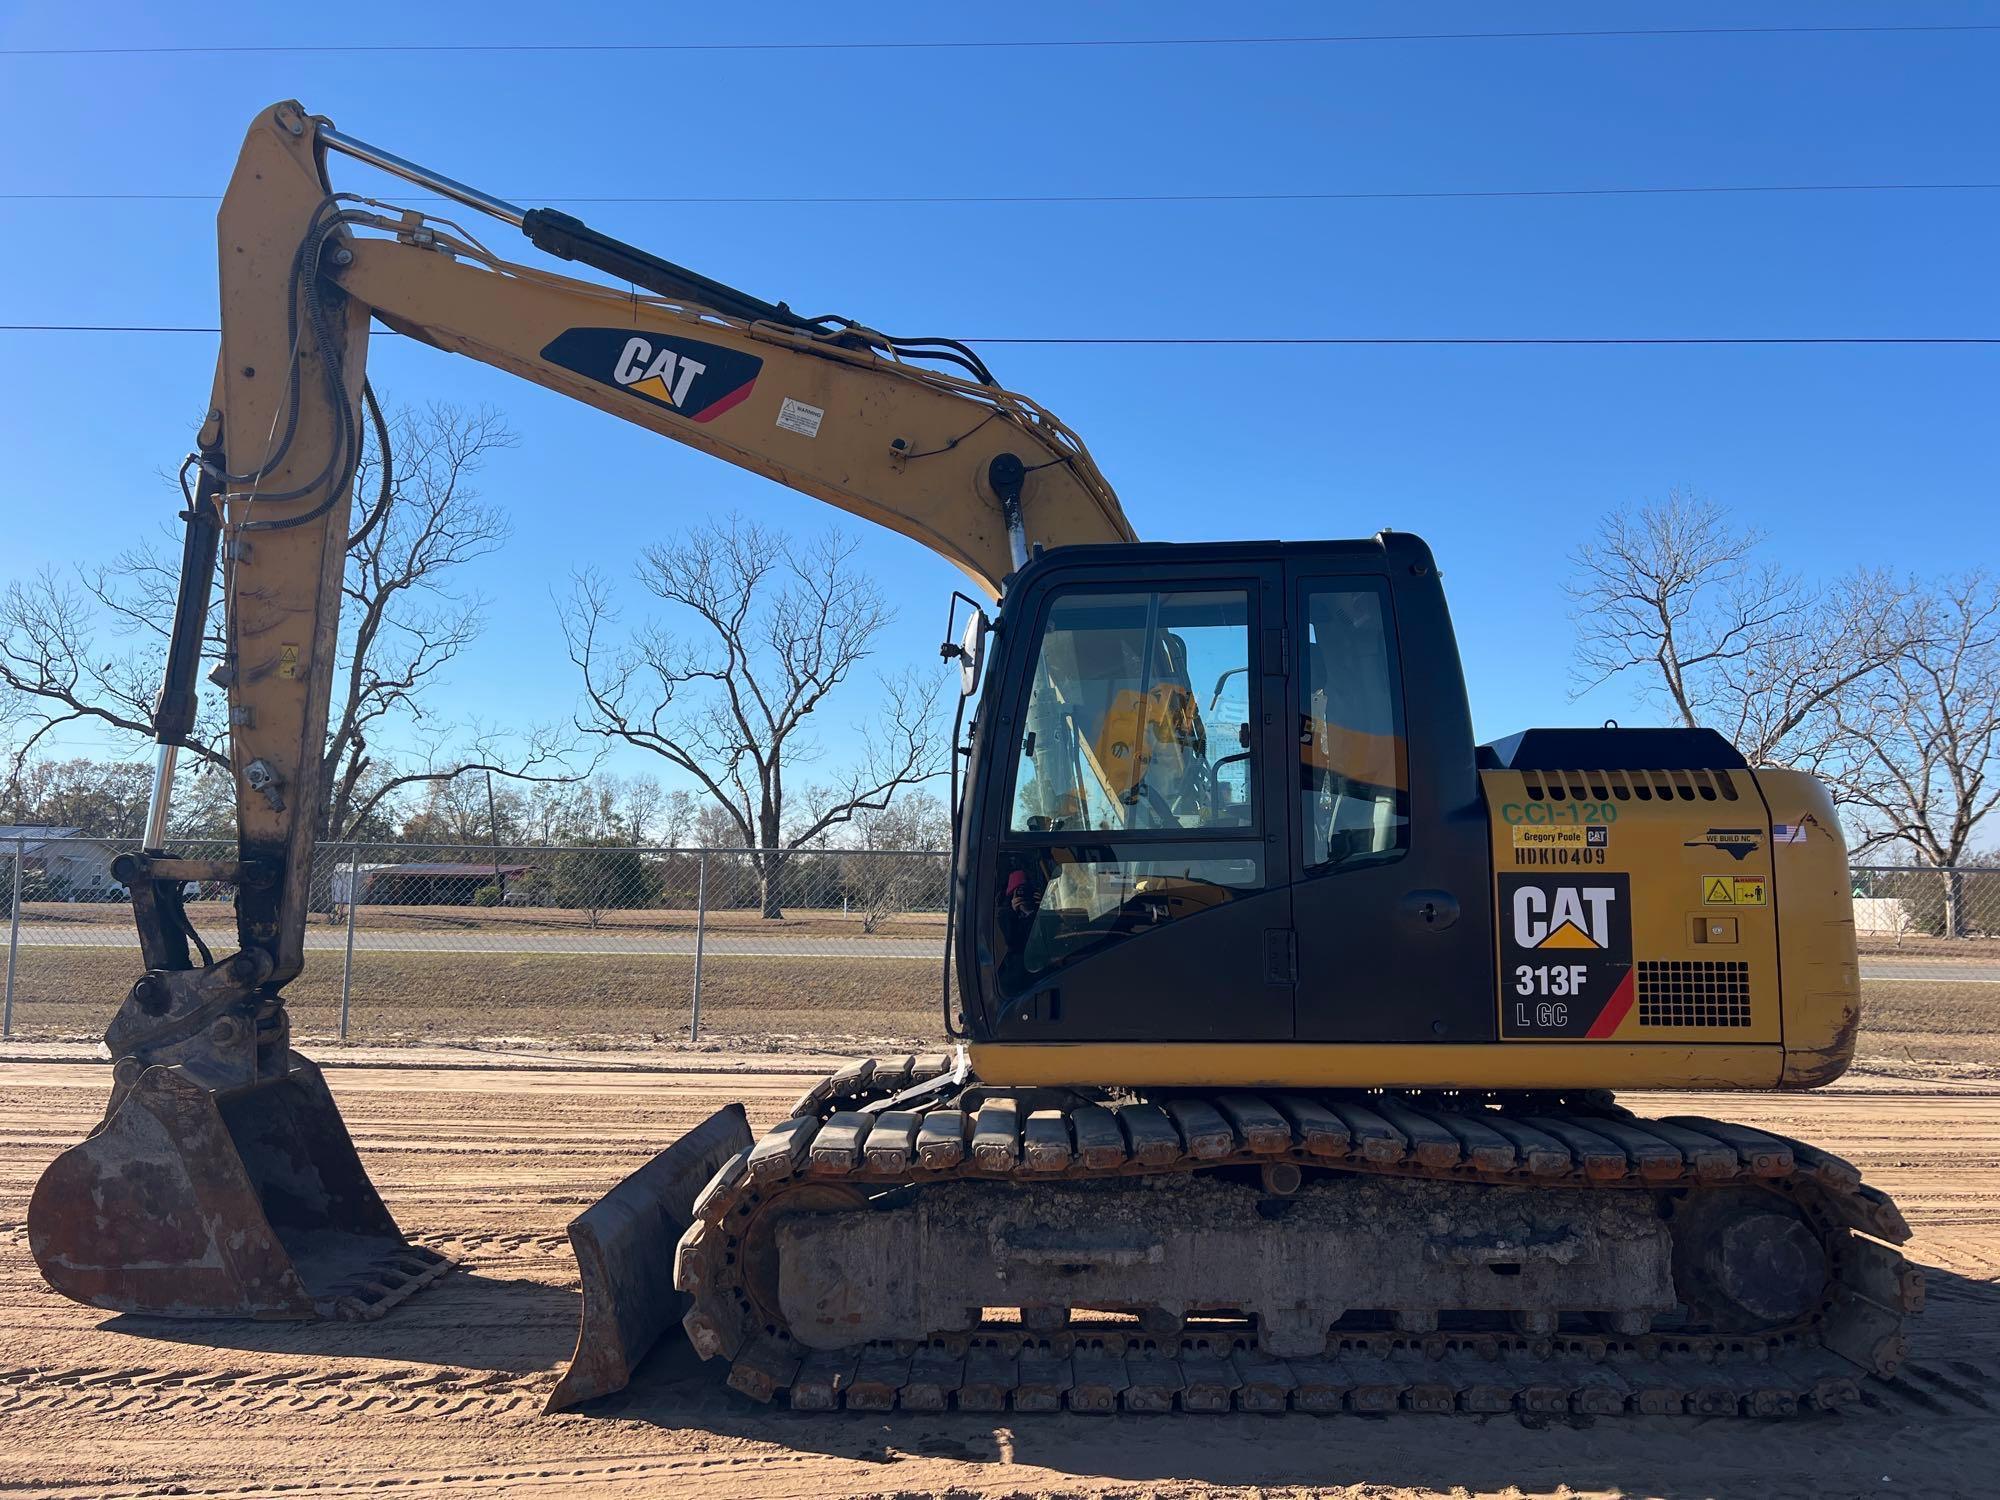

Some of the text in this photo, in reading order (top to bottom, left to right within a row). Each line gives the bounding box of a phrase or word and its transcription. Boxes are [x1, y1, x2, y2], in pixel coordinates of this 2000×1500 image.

[614, 337, 706, 408] CAT
[1502, 803, 1617, 825] CCI-120
[1524, 832, 1581, 843] Gregory Poole
[1587, 831, 1606, 842] CAT
[1513, 886, 1615, 949] CAT
[1515, 965, 1587, 996] 313F
[1516, 1003, 1568, 1027] L GC
